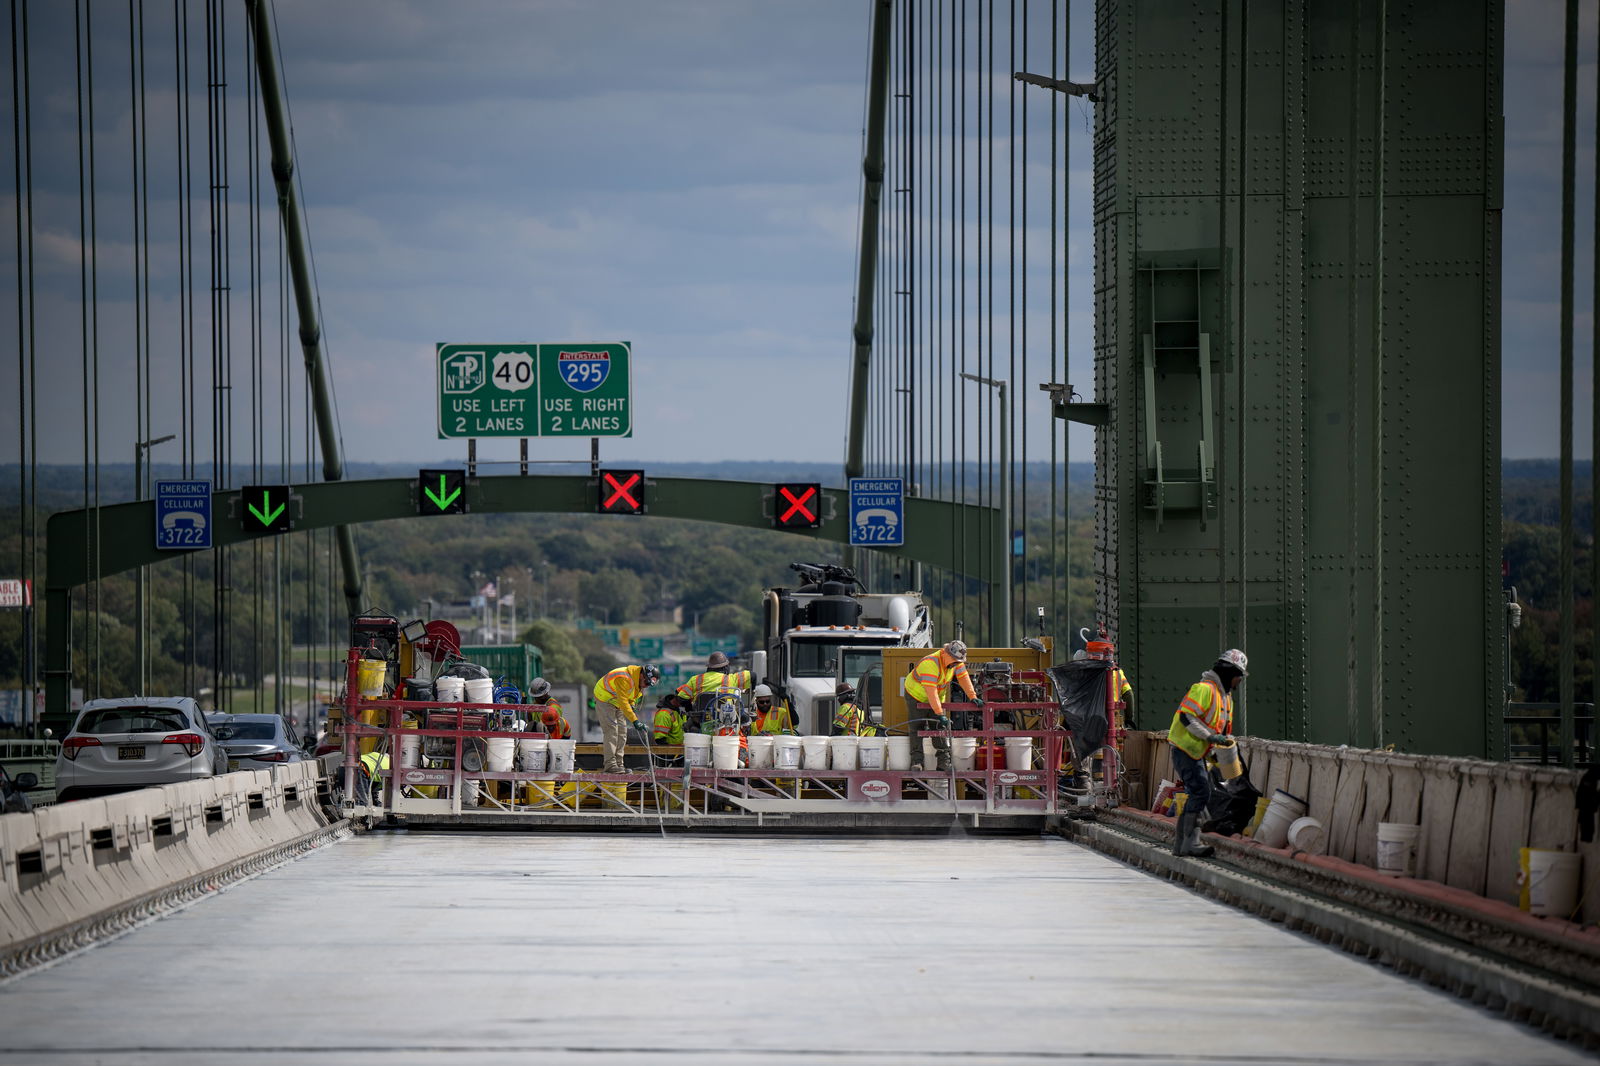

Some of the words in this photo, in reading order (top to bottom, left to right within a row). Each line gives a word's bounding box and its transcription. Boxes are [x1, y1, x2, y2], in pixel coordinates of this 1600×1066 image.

[495, 361, 530, 383] 40
[567, 363, 602, 383] 295
[453, 399, 481, 412] USE
[491, 399, 526, 412] LEFT
[544, 399, 573, 412] USE
[583, 398, 626, 412] RIGHT
[455, 417, 467, 432] 2
[476, 418, 525, 431] LANES
[551, 416, 563, 431] 2
[571, 417, 620, 430] LANES
[160, 485, 207, 494] EMERGENCY
[854, 482, 898, 490] EMERGENCY
[164, 500, 204, 508] CELLULAR
[857, 497, 896, 506] CELLULAR
